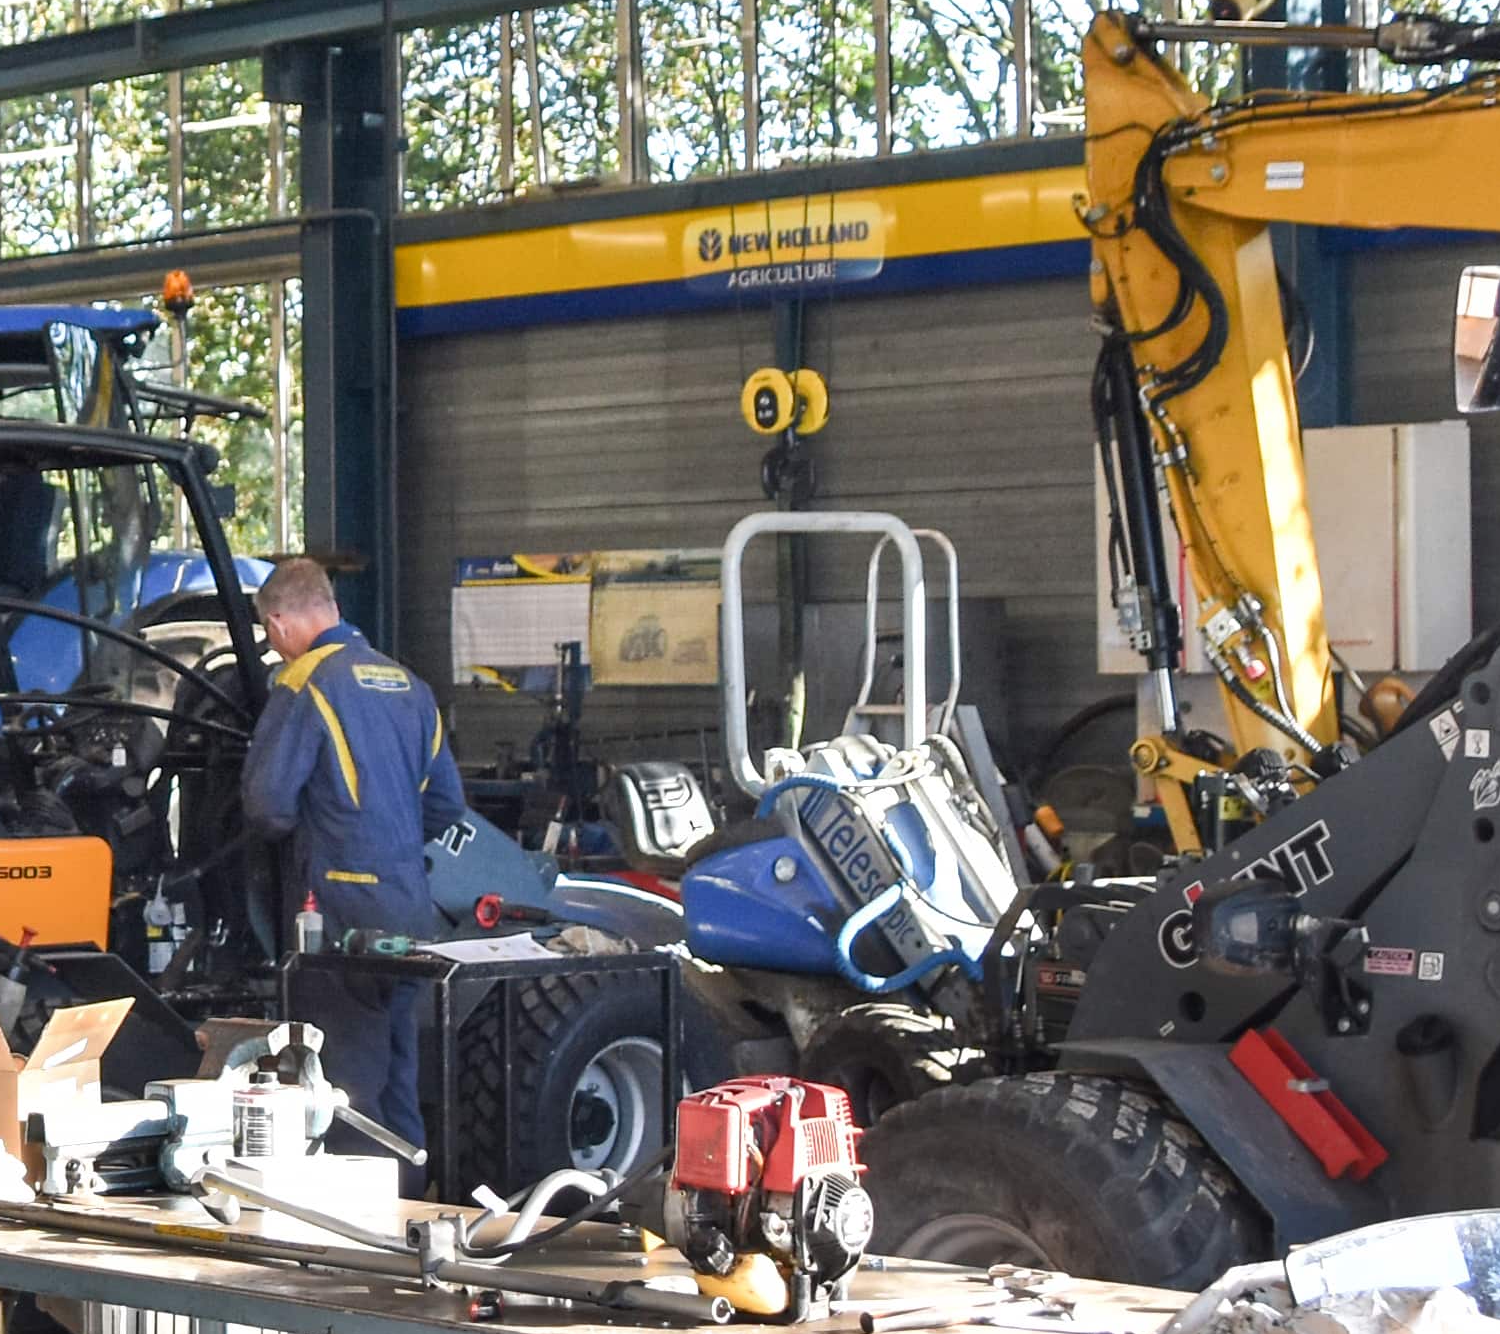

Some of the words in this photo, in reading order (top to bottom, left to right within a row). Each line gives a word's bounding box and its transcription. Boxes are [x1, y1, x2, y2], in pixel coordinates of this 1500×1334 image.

[728, 230, 772, 256] NEW
[777, 220, 870, 249] HOLLAND
[727, 260, 836, 289] AGRICULTURE
[1157, 818, 1335, 969] GNT
